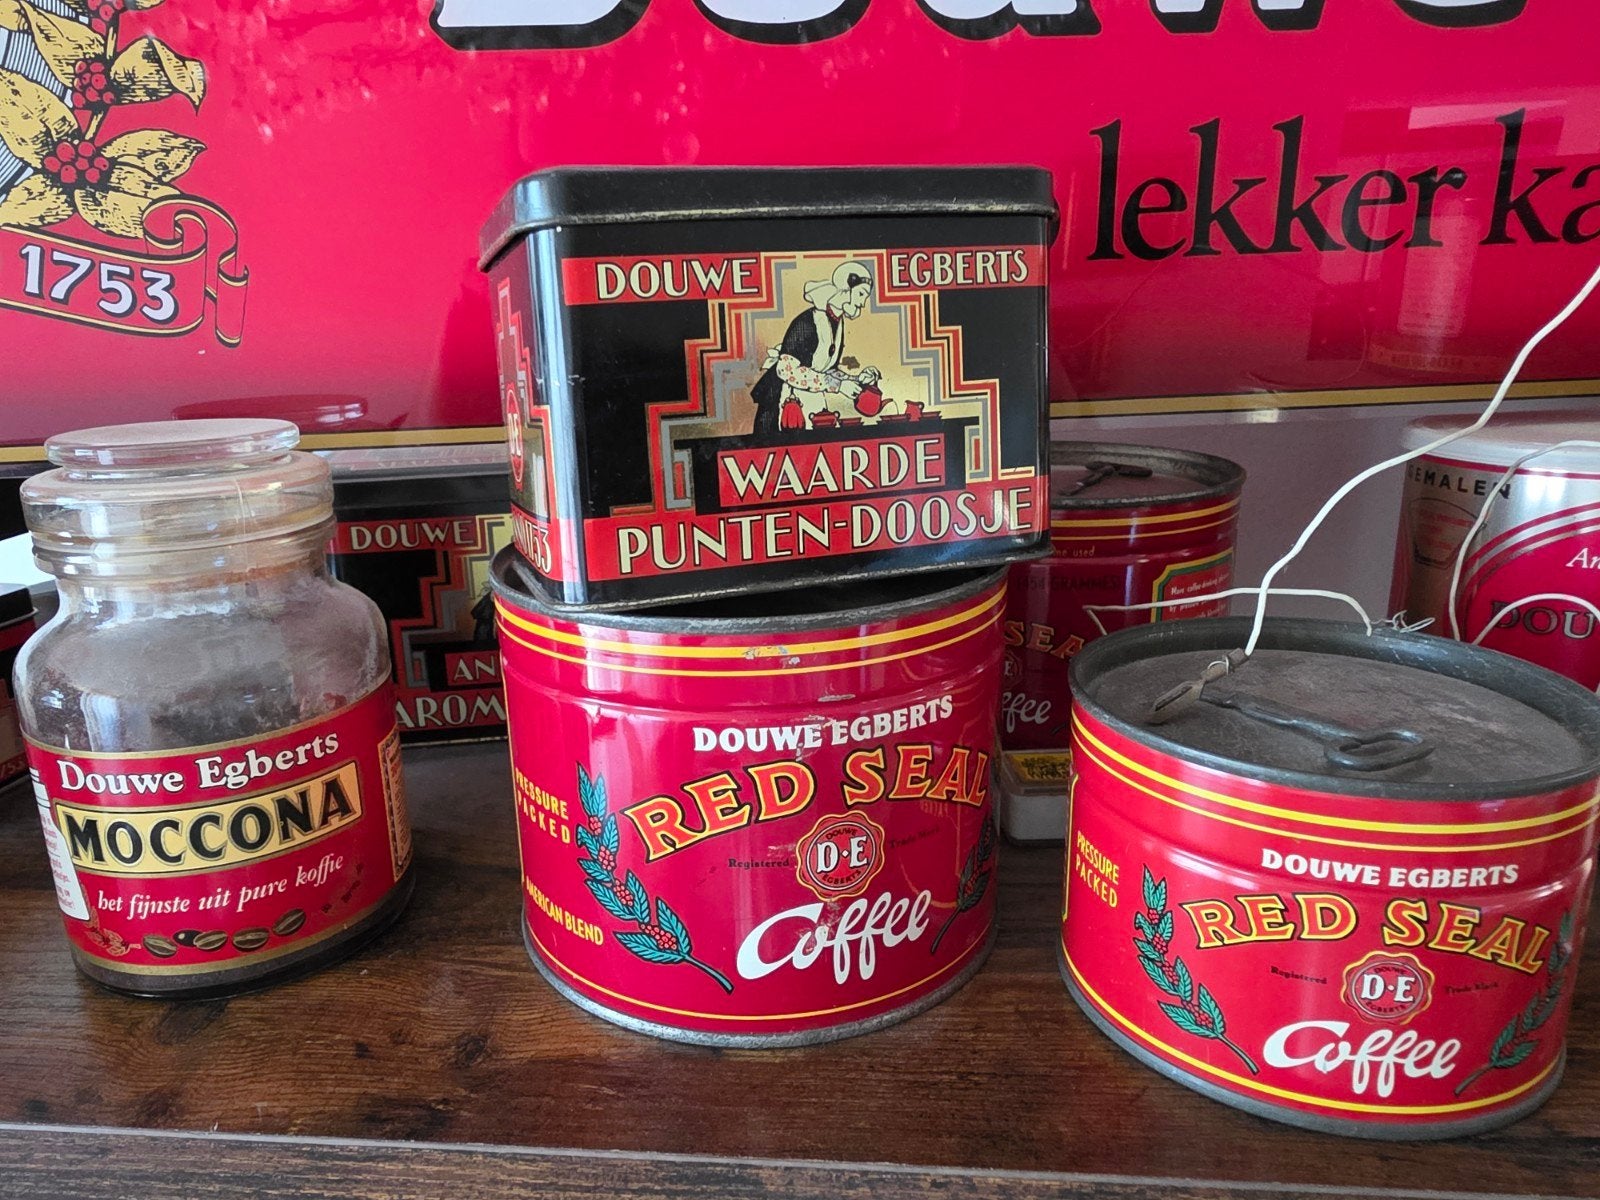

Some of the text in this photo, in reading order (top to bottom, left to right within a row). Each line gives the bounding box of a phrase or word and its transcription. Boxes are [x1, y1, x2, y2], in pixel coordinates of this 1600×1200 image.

[1087, 114, 1468, 262] lekker
[20, 243, 179, 325] 1753
[595, 248, 1029, 301] DOUWE EGBERTS
[720, 437, 942, 500] WAARDE
[349, 520, 476, 551] DOUWE
[617, 485, 1034, 576] PUNTEN-DOOSJE
[693, 695, 954, 753] DOUWE EGBERTS
[56, 732, 340, 796] Douwe Egberts
[515, 767, 570, 821] PRESSURE
[62, 773, 357, 867] MOCCONA
[516, 790, 571, 844] PACKED
[621, 744, 991, 864] RED SEAL
[825, 827, 858, 841] DOUWE
[97, 853, 343, 921] het fijnste uit pure koffie
[728, 857, 790, 870] Registered
[822, 869, 862, 886] EGBERTS
[1075, 853, 1118, 908] PACKED
[1077, 830, 1120, 885] PRESSURE
[1261, 848, 1519, 889] DOUWE EGBERTS
[526, 876, 604, 946] AMERICAN BLEND
[736, 889, 932, 985] Coffee
[1181, 891, 1554, 975] RED SEAL
[1270, 965, 1328, 985] Registered
[1262, 1020, 1461, 1098] Coffee
